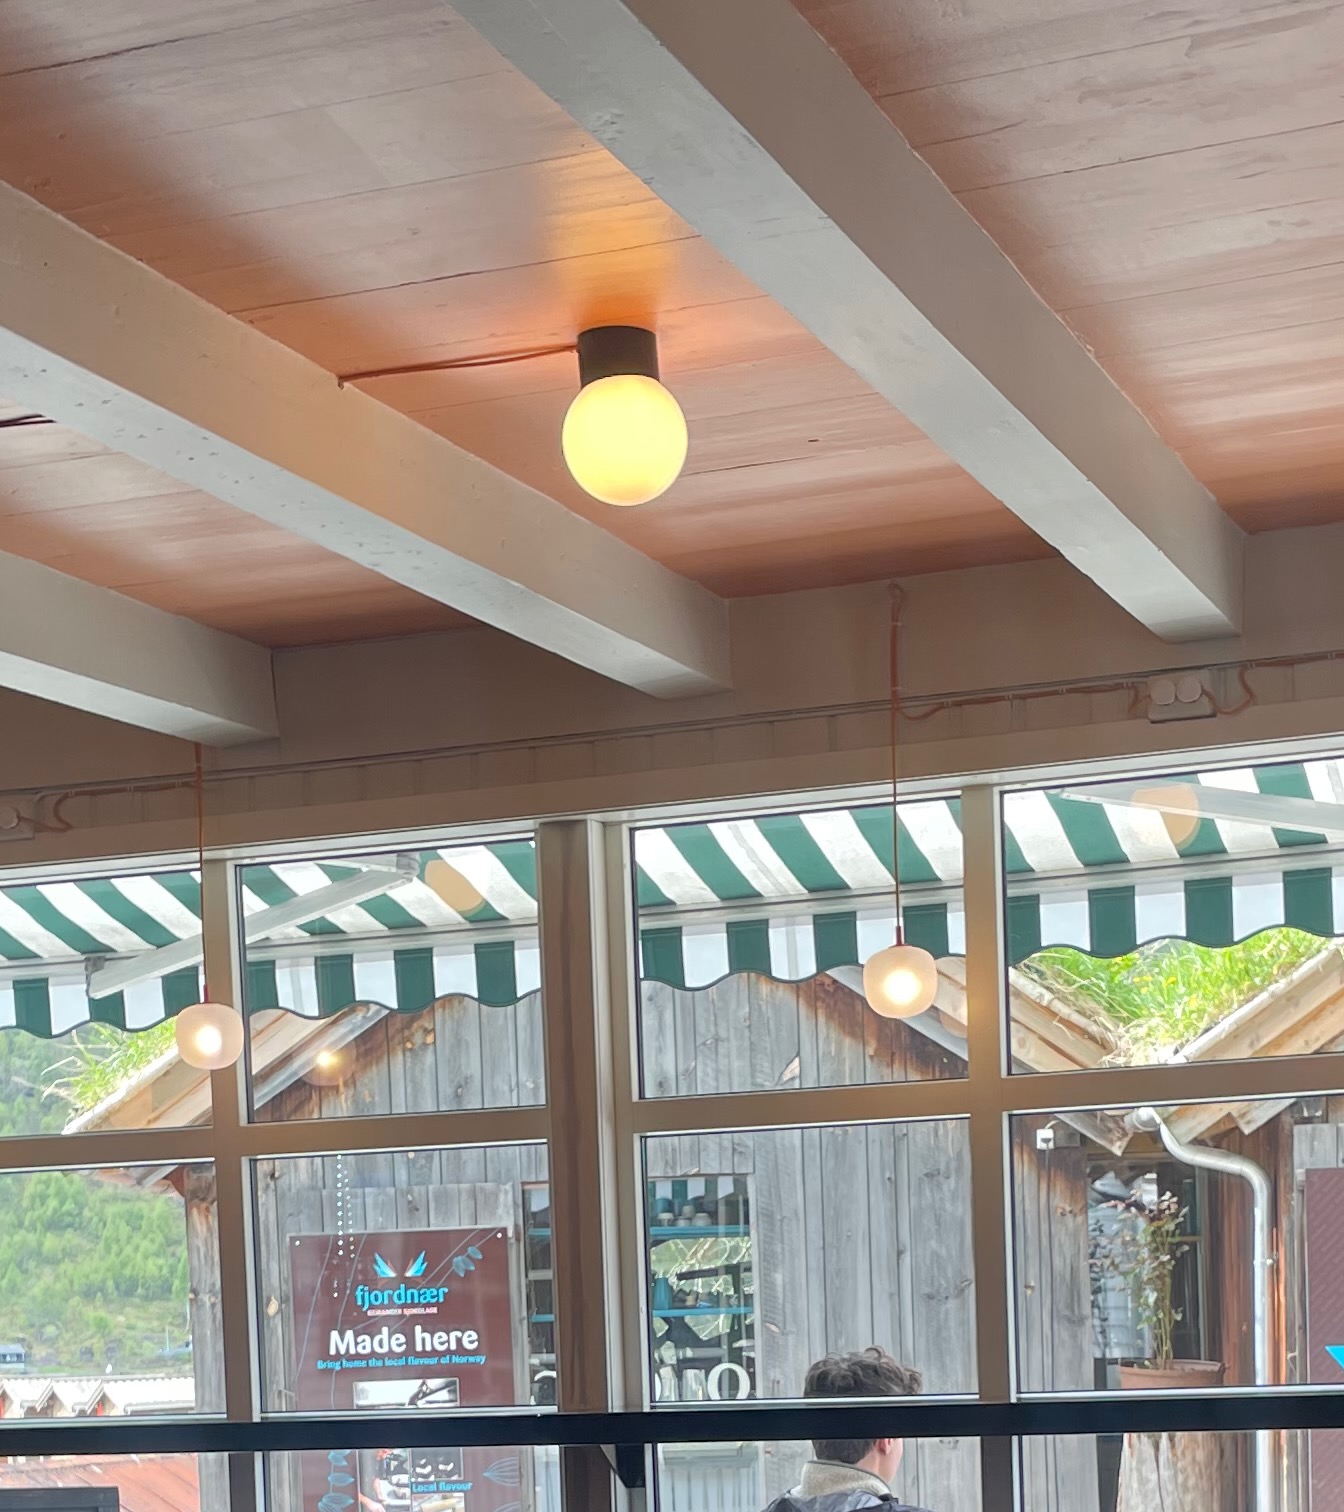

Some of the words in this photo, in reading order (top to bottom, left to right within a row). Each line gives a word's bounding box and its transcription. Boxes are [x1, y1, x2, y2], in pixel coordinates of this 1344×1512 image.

[355, 1284, 448, 1311] fjordnær
[329, 1326, 406, 1356] Made
[414, 1325, 479, 1352] here
